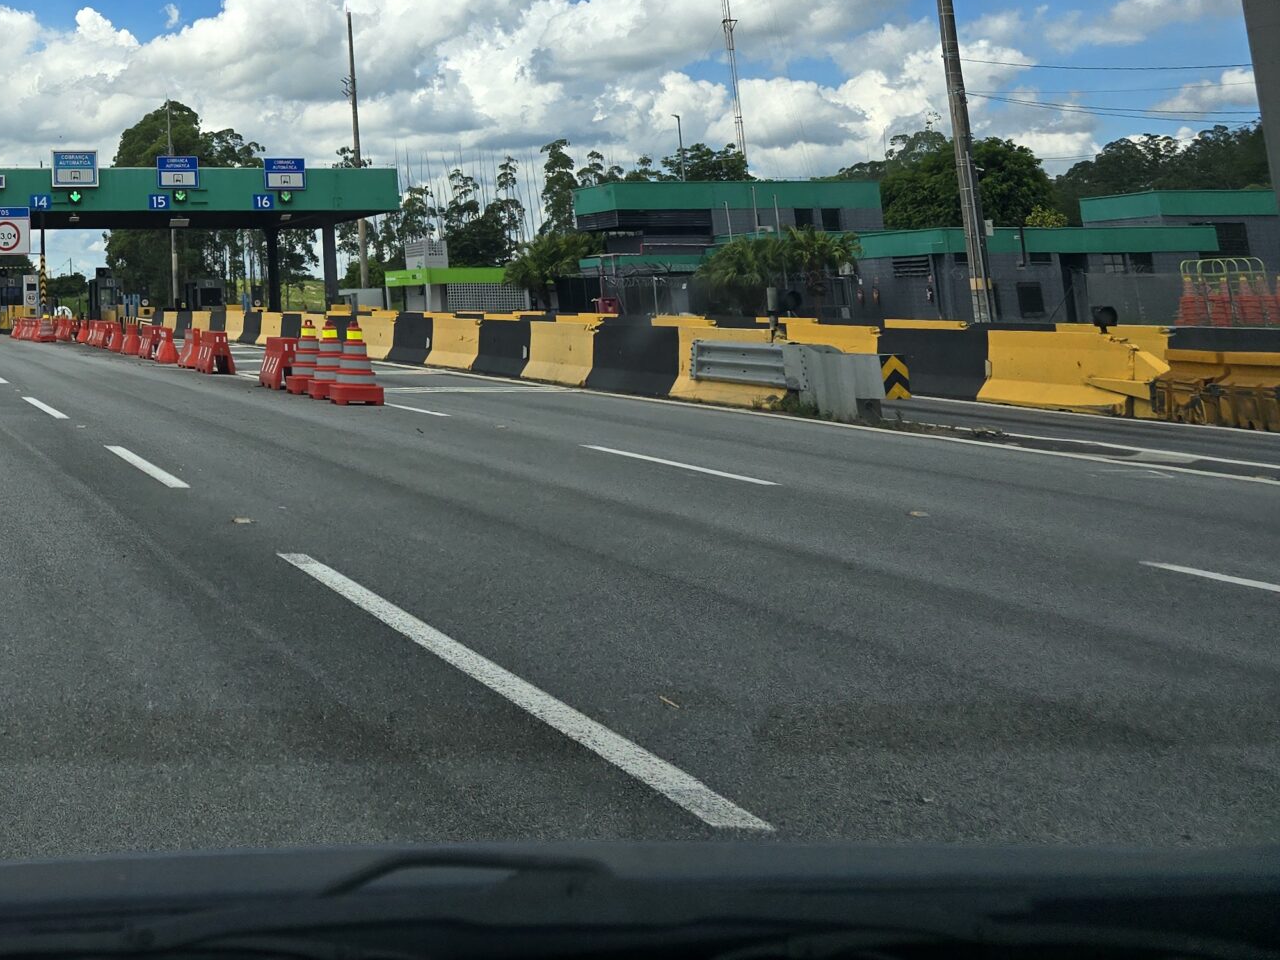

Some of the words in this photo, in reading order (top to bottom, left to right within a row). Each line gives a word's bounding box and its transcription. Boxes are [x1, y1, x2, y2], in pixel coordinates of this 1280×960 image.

[33, 196, 48, 208] 14
[152, 195, 166, 208] 15
[256, 195, 271, 208] 16
